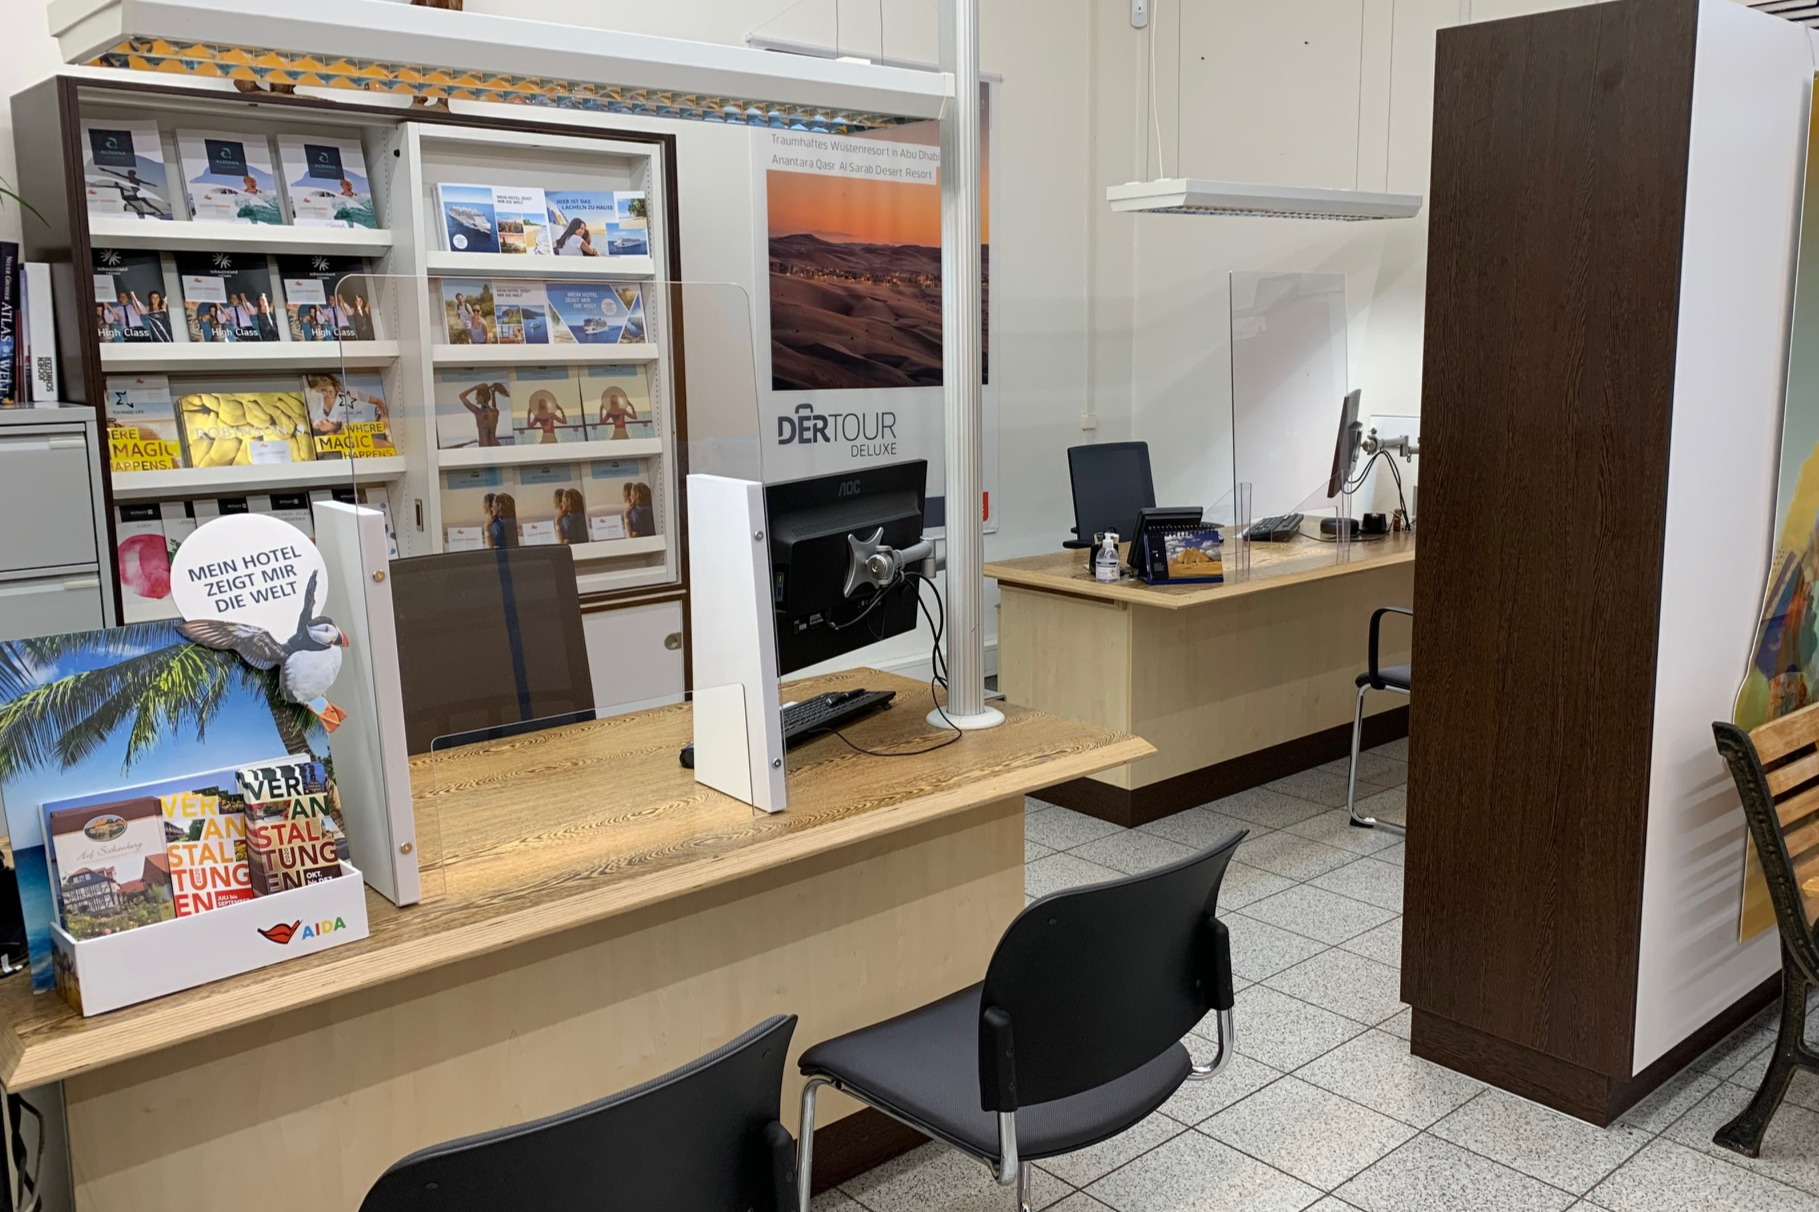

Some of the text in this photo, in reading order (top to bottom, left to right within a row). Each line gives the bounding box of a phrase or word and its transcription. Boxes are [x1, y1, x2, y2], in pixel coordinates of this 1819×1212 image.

[771, 133, 828, 150] Traumhaftes
[891, 147, 898, 157] in
[899, 148, 917, 160] Abu
[771, 154, 932, 180] Anantara Qasr Al Sarab Desert Resort
[1, 302, 13, 342] ATLAS
[97, 327, 150, 338] High Class
[211, 327, 259, 338] High Class
[311, 328, 331, 338] High
[108, 428, 137, 440] ERE
[195, 424, 288, 439] ROBINSON
[345, 423, 384, 433] WHERE
[777, 408, 897, 445] DERTOUR
[112, 441, 174, 458] MAGIC
[319, 435, 371, 450] MAGIC
[850, 442, 897, 458] DELUXE
[110, 459, 171, 471] APPENS.
[838, 479, 861, 497] AOC
[187, 545, 302, 582] MEIN HOTEL
[203, 564, 297, 597] ZEIGT MIR
[215, 581, 297, 613] DIE WELT
[246, 776, 303, 801] VER
[161, 794, 218, 818] VER
[291, 795, 330, 820] AN
[204, 816, 246, 840] AN
[256, 821, 321, 849] STAL
[167, 841, 234, 868] STAL
[260, 841, 339, 871] TUNG
[171, 863, 252, 892] TUNG
[267, 870, 303, 893] EN
[306, 870, 323, 879] OKT.
[174, 891, 214, 917] EN
[217, 898, 251, 907] SEPTEM
[302, 916, 346, 940] AIDA
